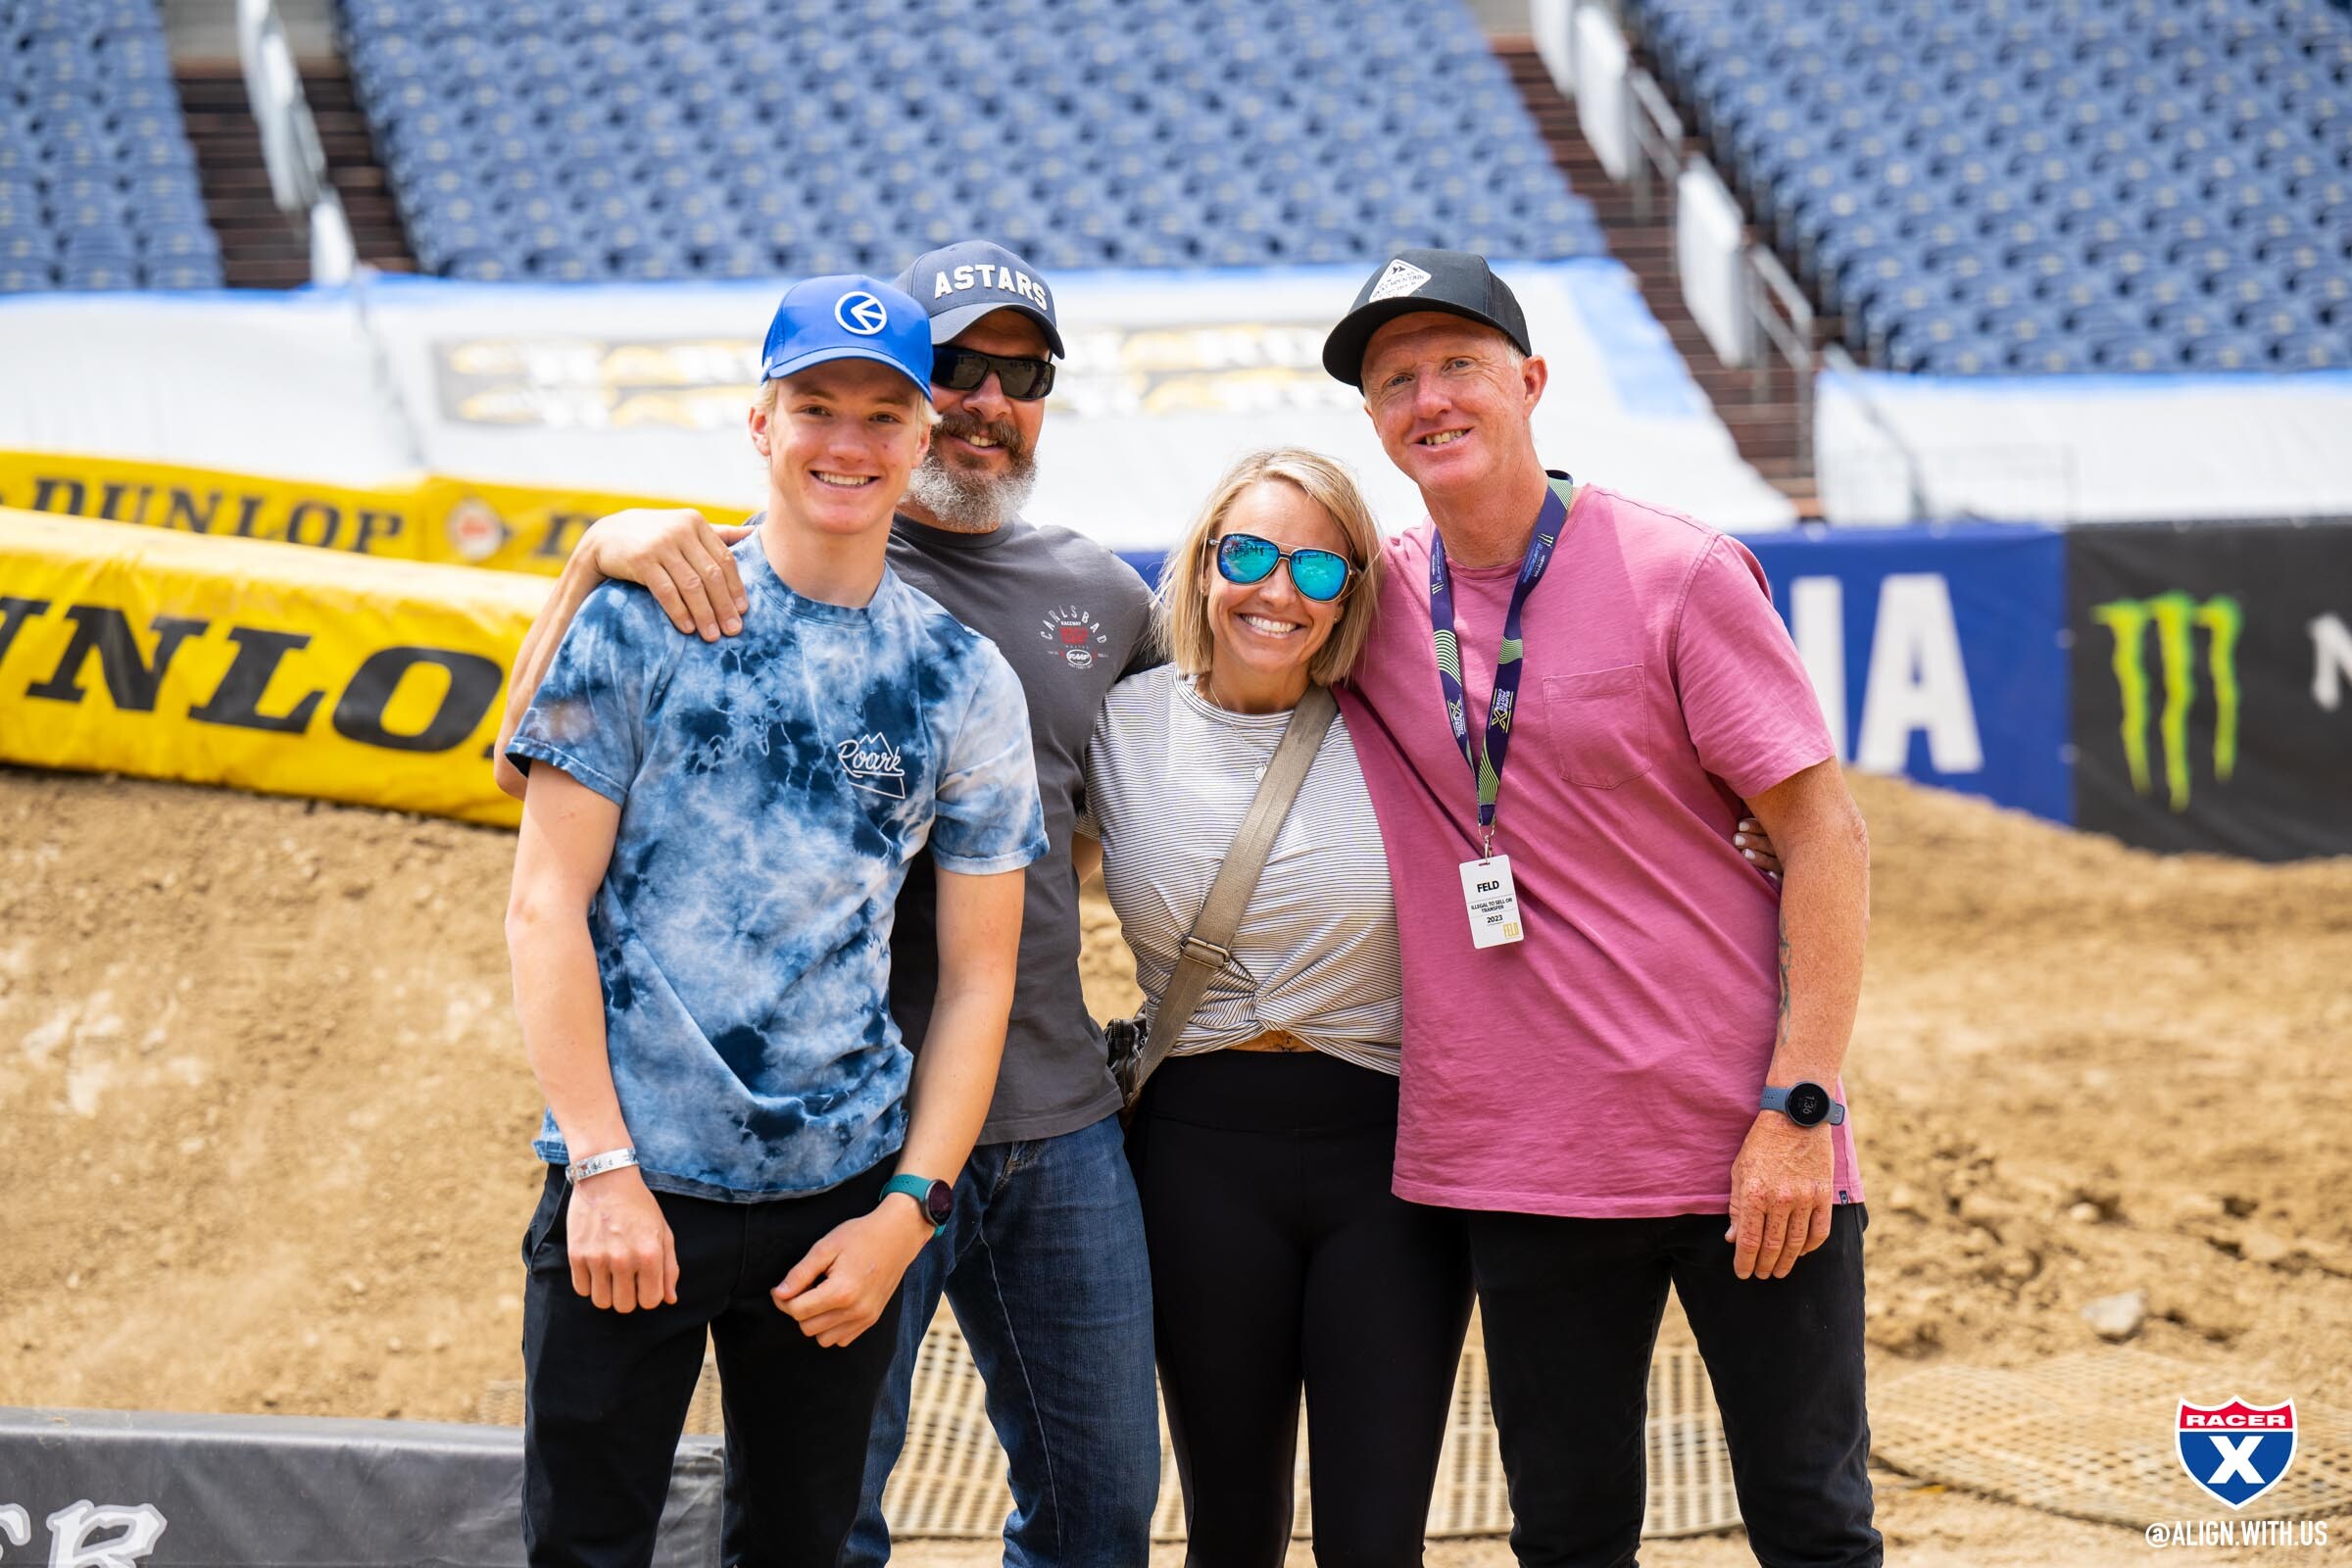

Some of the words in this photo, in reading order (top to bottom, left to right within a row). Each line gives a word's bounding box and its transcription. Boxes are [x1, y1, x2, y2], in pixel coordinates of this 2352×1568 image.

[934, 264, 1048, 312] ASTARS
[33, 476, 404, 555] DUNLOP
[1040, 605, 1107, 643] CARLSBAD
[0, 596, 504, 760] NLO
[838, 739, 906, 779] Roark
[1477, 880, 1499, 893] FELD
[1481, 905, 1504, 913] TRANSFER
[1486, 914, 1503, 924] 2023
